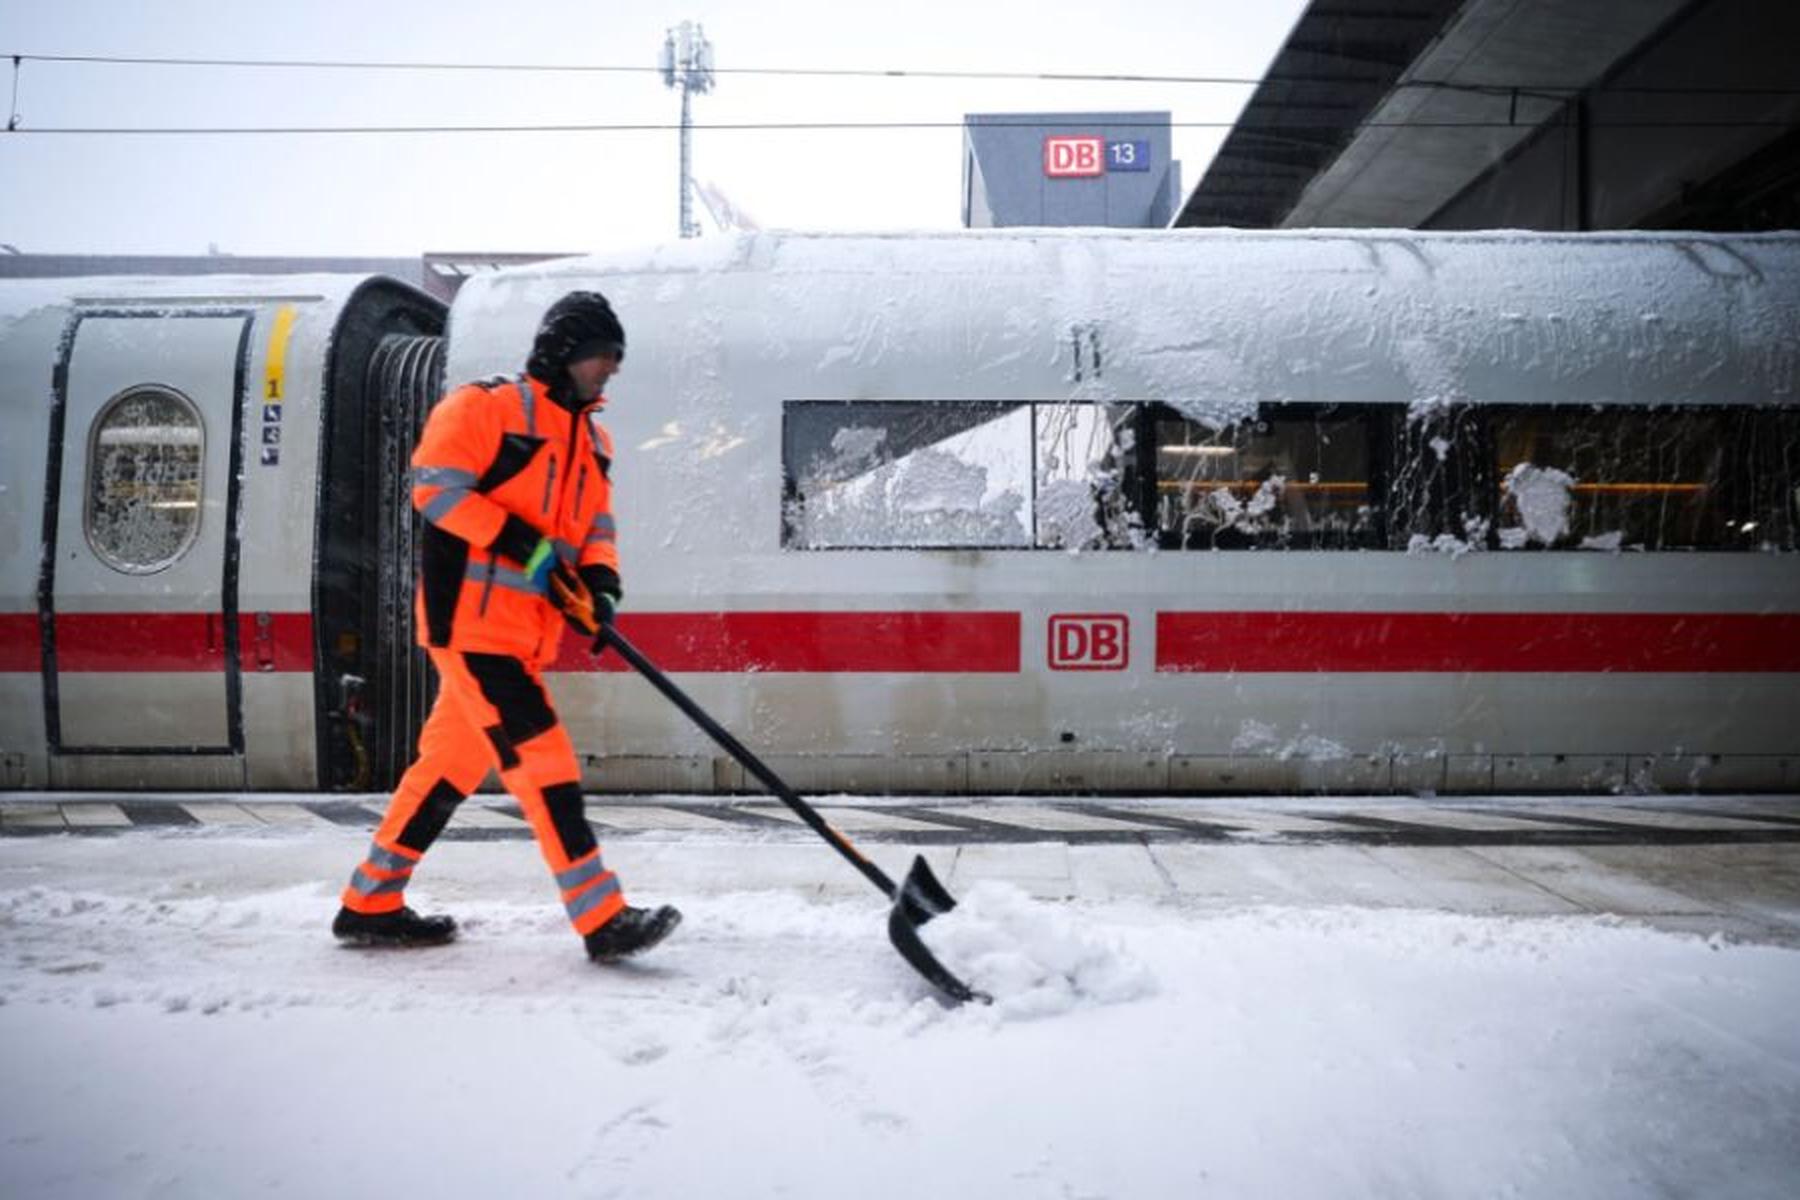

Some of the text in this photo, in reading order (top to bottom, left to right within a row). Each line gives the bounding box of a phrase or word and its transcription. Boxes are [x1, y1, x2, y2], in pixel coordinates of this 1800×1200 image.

[1053, 143, 1135, 169] DB 13
[268, 379, 280, 398] 1
[1058, 623, 1119, 661] DB
